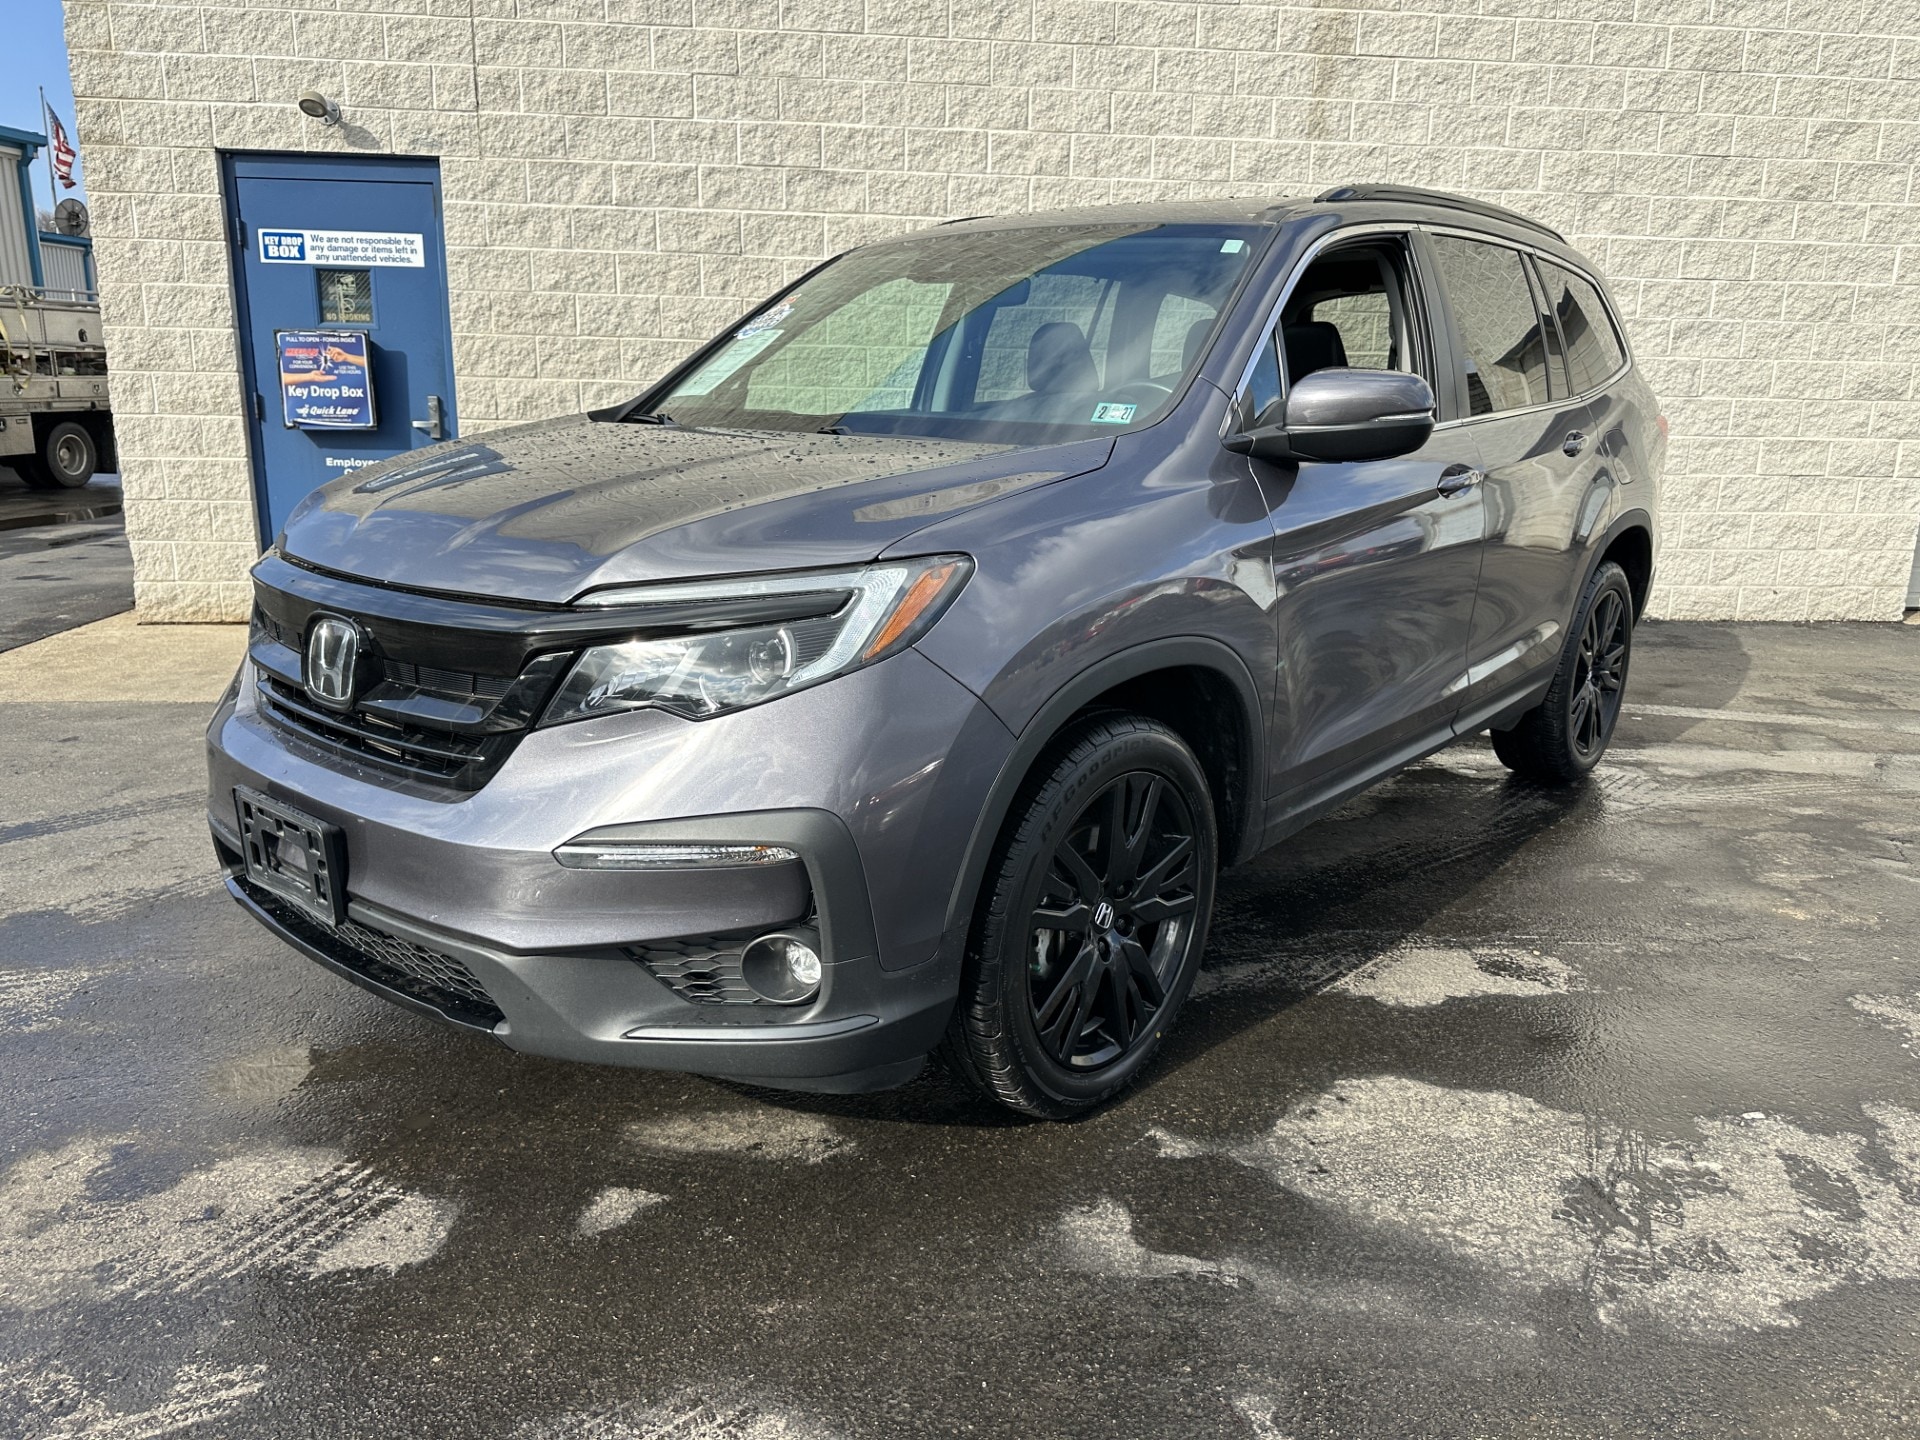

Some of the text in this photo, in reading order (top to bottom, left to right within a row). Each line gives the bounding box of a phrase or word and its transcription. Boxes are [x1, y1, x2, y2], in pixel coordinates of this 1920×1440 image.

[264, 236, 303, 245] KEY DROP
[310, 234, 324, 243] We
[356, 237, 402, 246] responsible
[268, 245, 301, 258] BOX
[310, 245, 324, 253] any
[327, 244, 358, 254] damage
[371, 246, 393, 254] items
[395, 246, 408, 254] left
[315, 254, 413, 263] any unattended vehicles.
[287, 385, 364, 400] Key Drop Box
[310, 405, 359, 415] Quick Lane
[1097, 405, 1133, 420] 2 27
[325, 457, 381, 468] Employe
